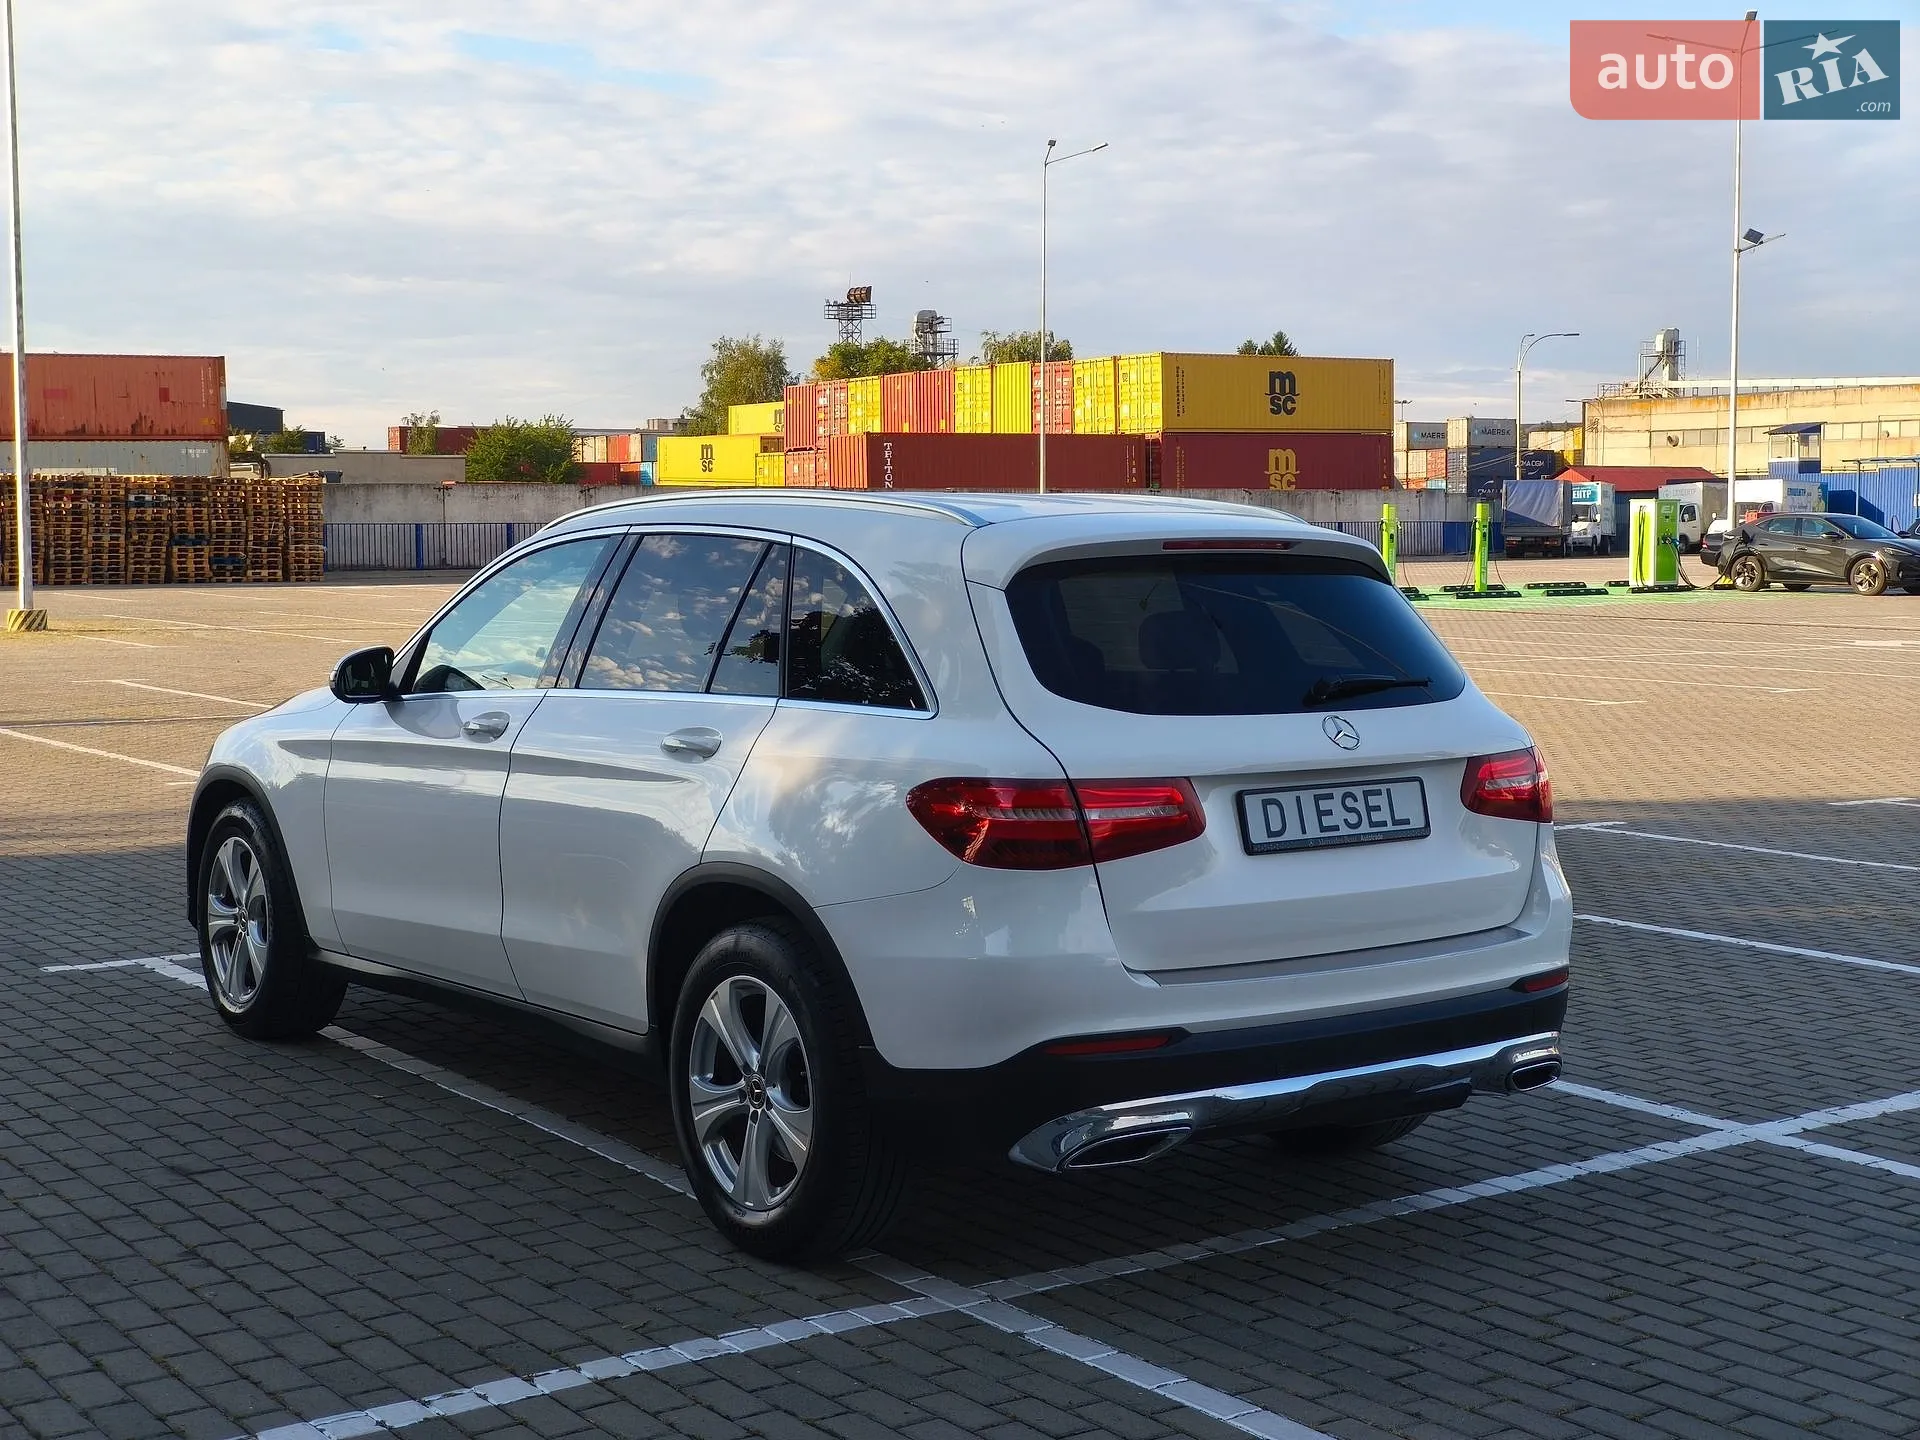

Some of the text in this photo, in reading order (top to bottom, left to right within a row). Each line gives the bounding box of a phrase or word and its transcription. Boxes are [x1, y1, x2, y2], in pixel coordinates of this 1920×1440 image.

[1481, 427, 1512, 436] MAERSK
[883, 442, 893, 489] TRITON
[1261, 788, 1411, 839] DIESEL
